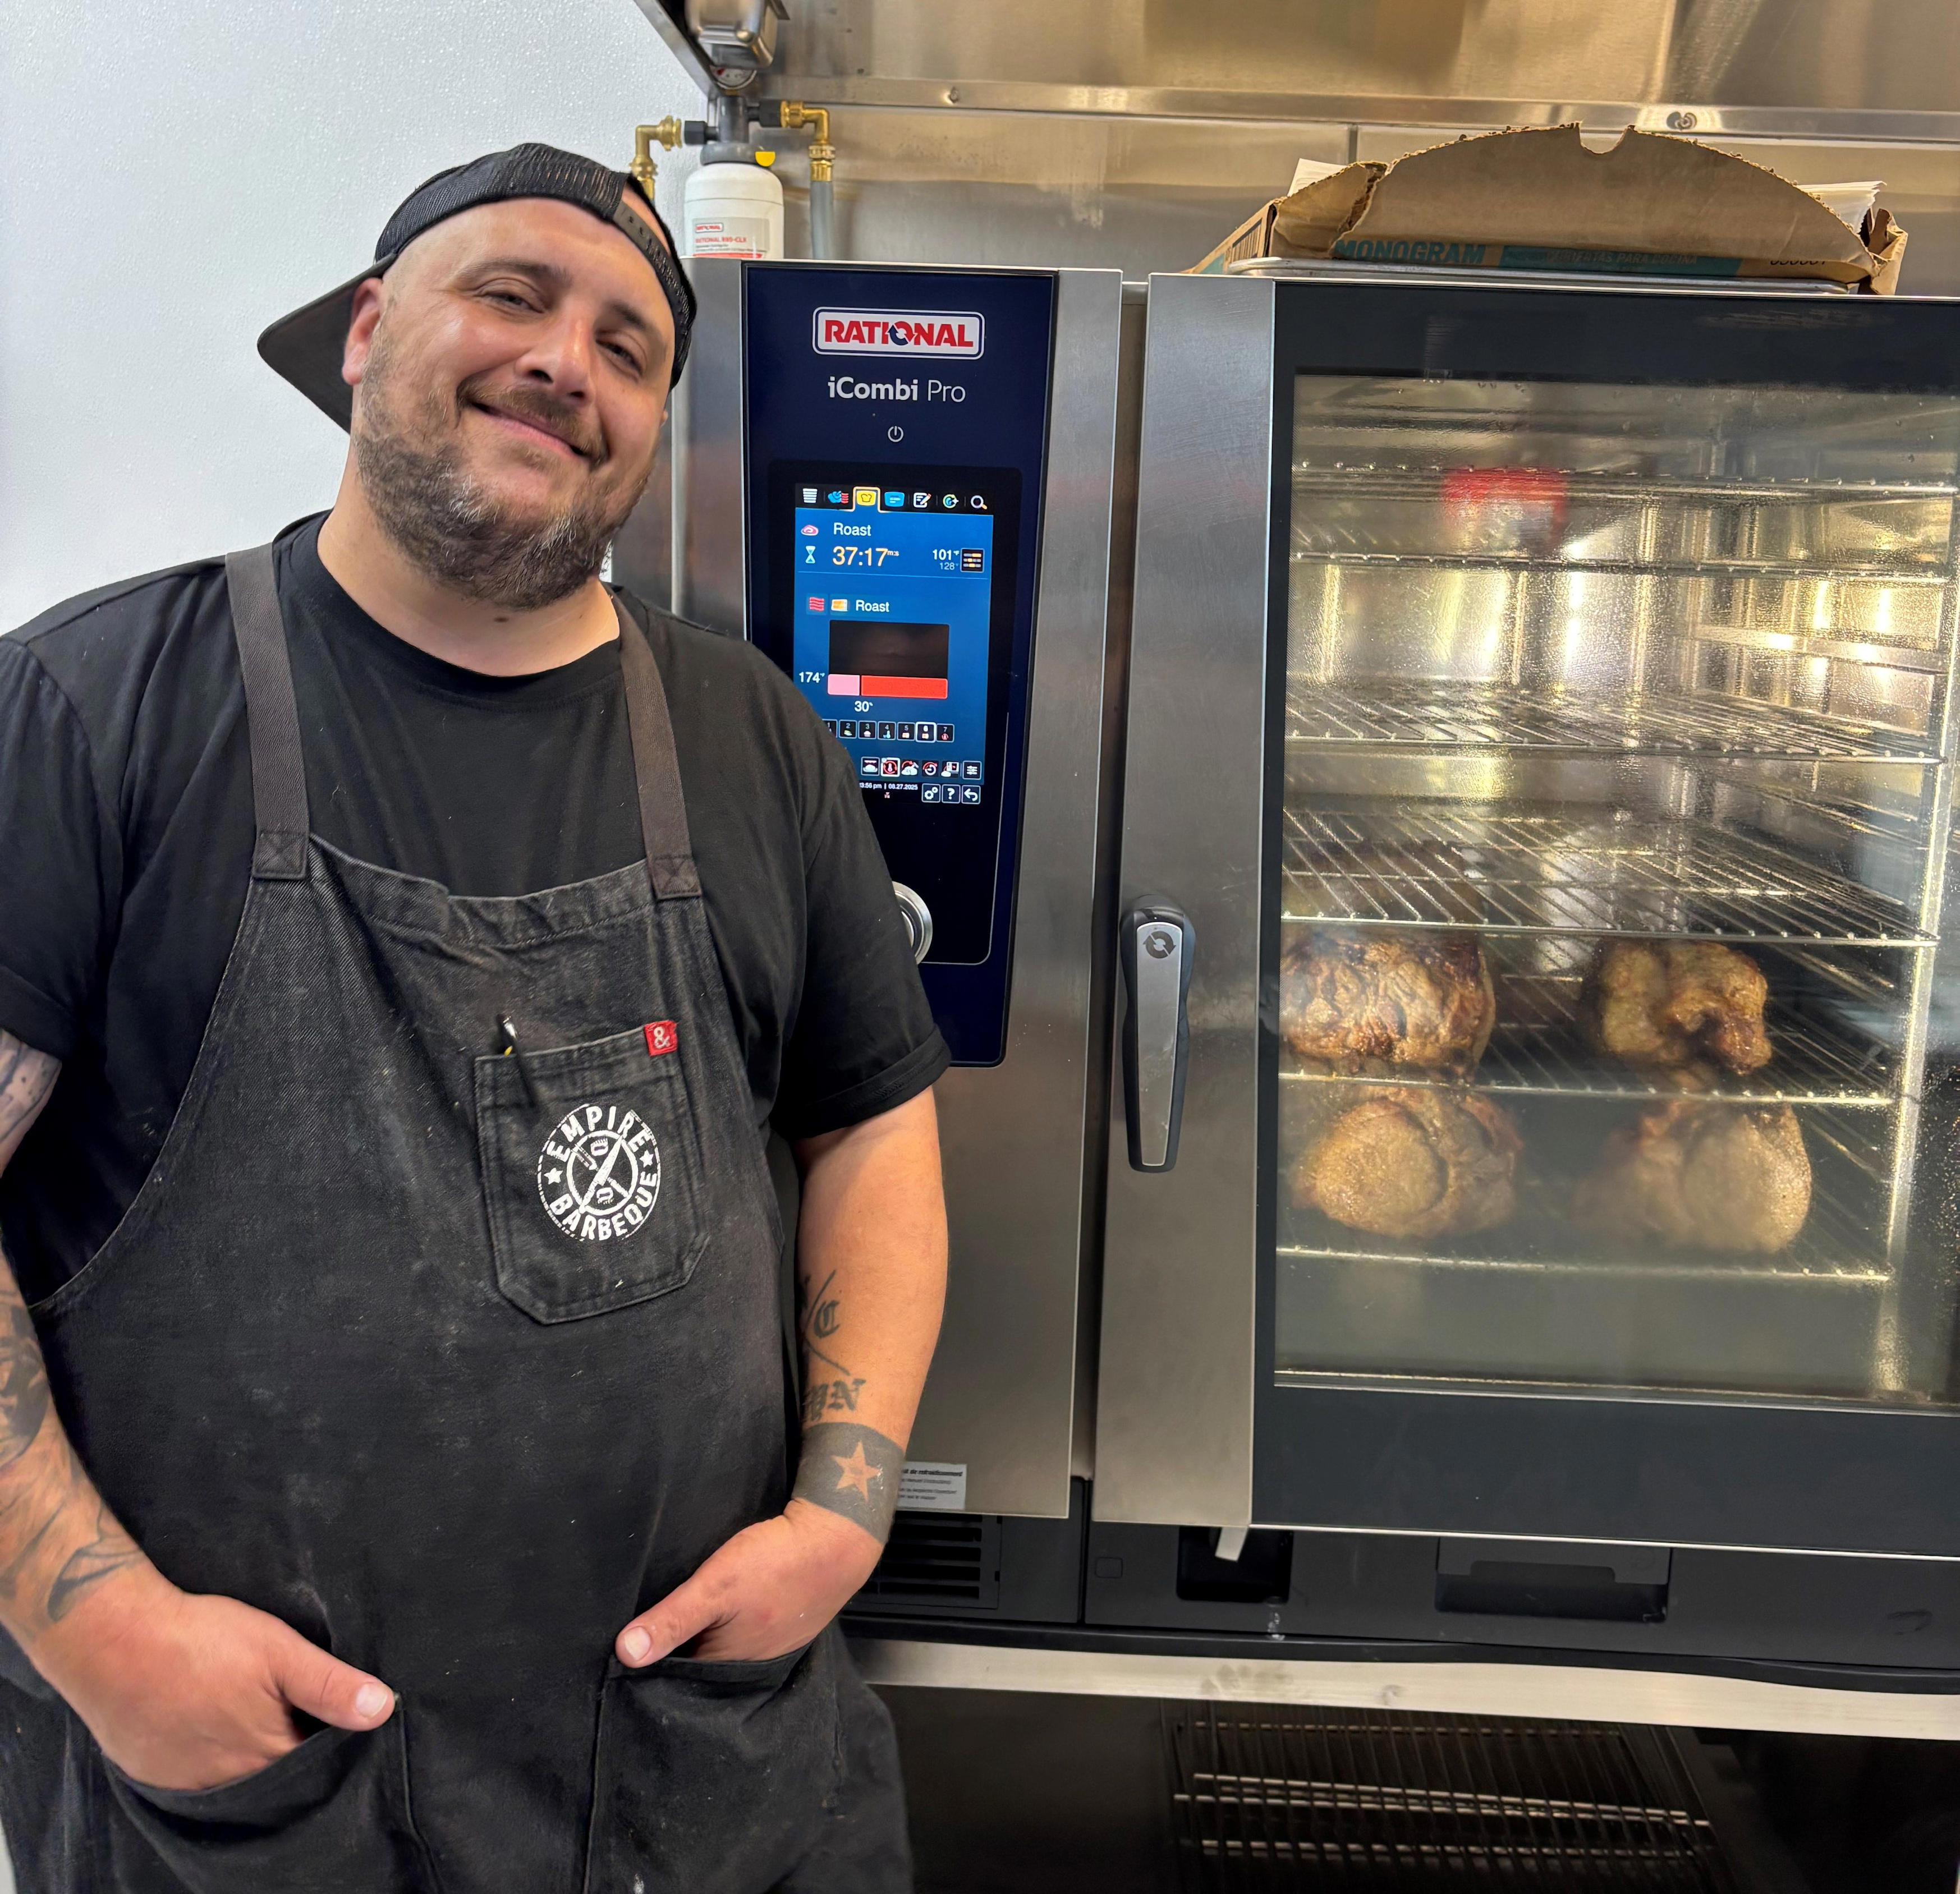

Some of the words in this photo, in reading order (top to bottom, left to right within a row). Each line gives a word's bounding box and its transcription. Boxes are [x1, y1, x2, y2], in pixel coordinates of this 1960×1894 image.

[1334, 240, 1486, 264] MONOGRAM
[825, 320, 974, 347] RATIONAL
[828, 376, 918, 401] iCombi
[928, 379, 966, 402] Pro
[833, 522, 871, 537] Roast
[833, 546, 888, 566] 37:17
[856, 600, 889, 613] Roast
[653, 1027, 670, 1049] &
[547, 1106, 653, 1162] EMPIRE
[549, 1171, 658, 1240] BARBEQUE
